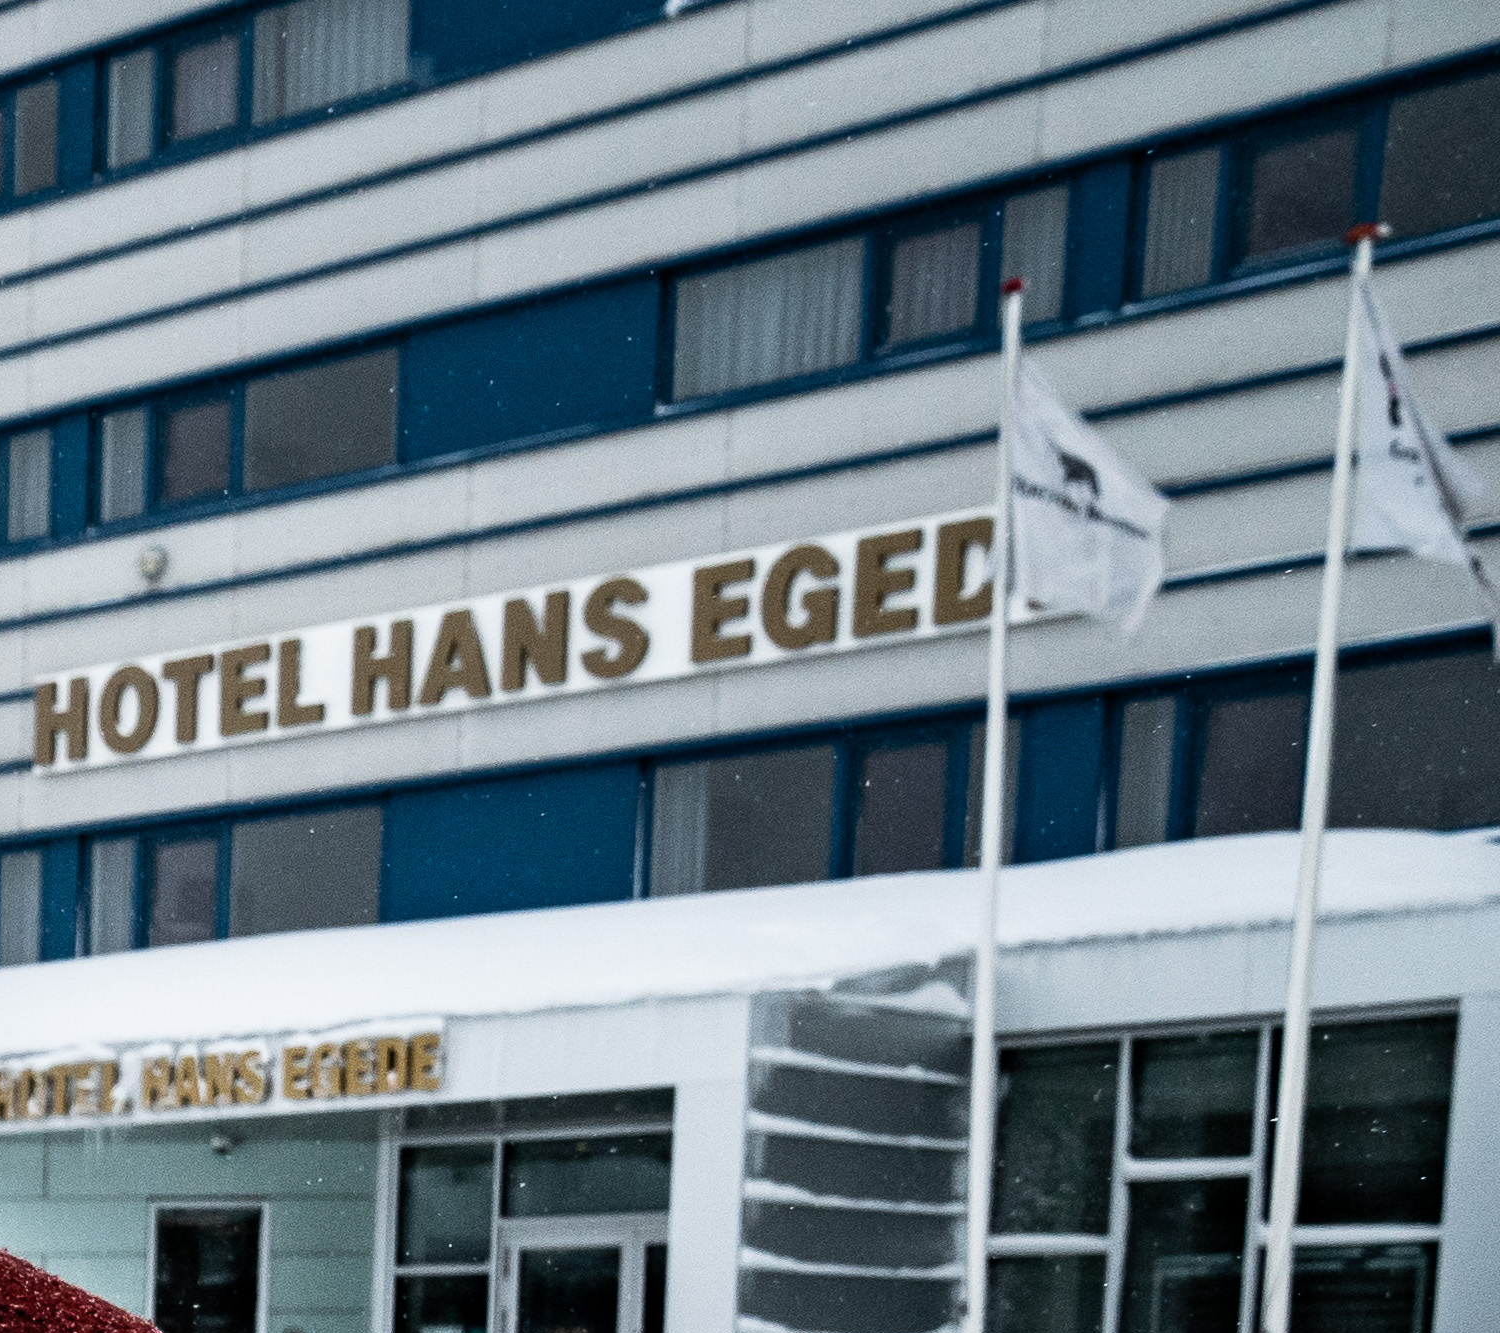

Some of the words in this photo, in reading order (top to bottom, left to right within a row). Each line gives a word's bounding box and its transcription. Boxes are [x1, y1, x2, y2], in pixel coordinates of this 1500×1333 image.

[33, 638, 325, 768] HOTEL
[350, 578, 650, 716] HANS
[692, 514, 995, 664] EGED
